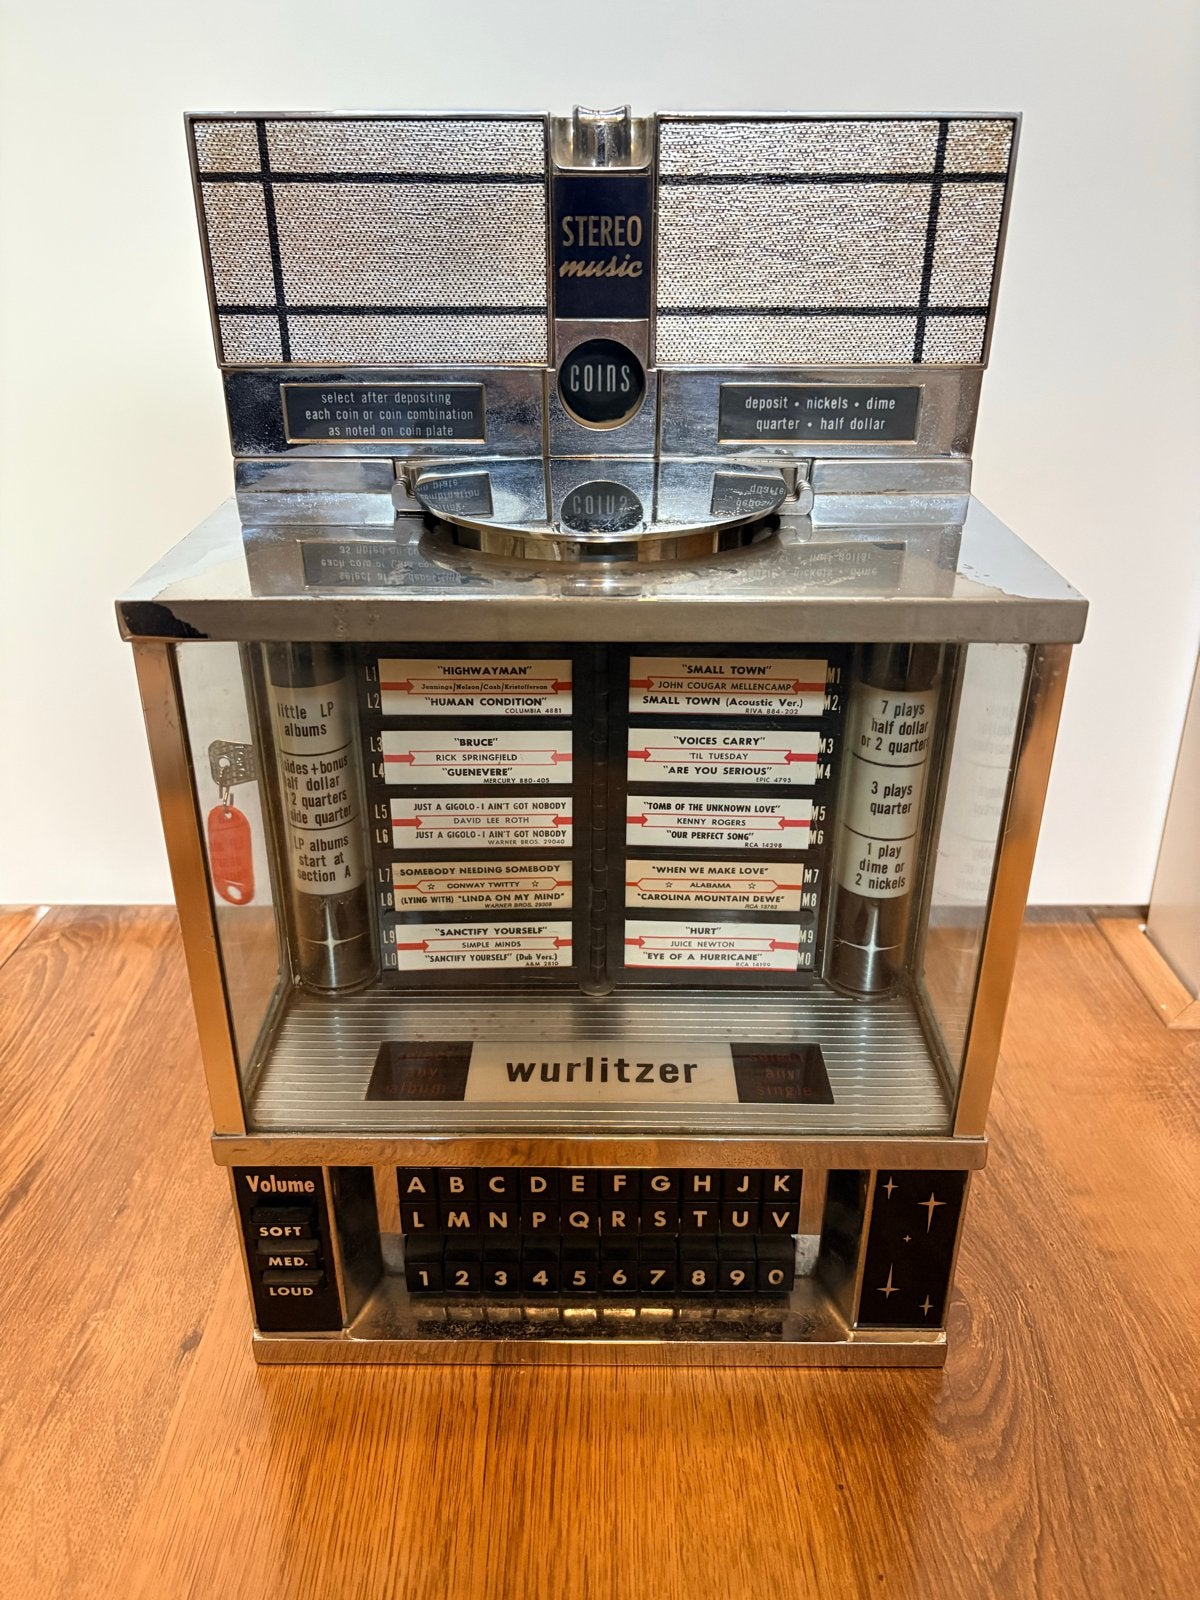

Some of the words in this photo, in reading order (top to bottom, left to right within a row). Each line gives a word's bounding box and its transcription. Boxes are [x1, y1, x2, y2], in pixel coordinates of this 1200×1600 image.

[562, 216, 642, 246] STEREO
[560, 254, 642, 278] music
[322, 392, 354, 404] select
[362, 392, 388, 403] after
[395, 392, 451, 405] depositing
[745, 397, 788, 411] deposit
[807, 397, 848, 409] nickels
[867, 398, 895, 409] dime
[306, 409, 330, 420] each
[336, 409, 358, 420] coin
[364, 411, 373, 420] or
[380, 409, 401, 420] coin
[407, 409, 473, 420] combination
[757, 419, 800, 431] quarter
[821, 418, 844, 429] half
[850, 418, 885, 429] dollar
[329, 427, 340, 435] as
[346, 425, 375, 436] noted
[381, 427, 393, 436] on
[400, 425, 421, 435] coin
[427, 425, 453, 438] plate
[438, 666, 531, 675] "HIGHWAYMAN"
[682, 664, 724, 674] "SMALL
[731, 666, 771, 675] TOWN"
[658, 681, 683, 689] JOHN
[688, 682, 727, 690] COUGAR
[731, 683, 792, 691] MELLENCAMP
[425, 697, 474, 706] "HUMAN
[480, 697, 547, 706] CONDITION"
[643, 696, 679, 705] SMALL
[686, 697, 720, 706] TOWN
[726, 697, 773, 707] (Acoustic
[780, 698, 803, 708] Ver.)
[277, 703, 306, 720] little
[321, 702, 334, 718] LP
[882, 700, 888, 714] 7
[894, 703, 925, 719] plays
[285, 723, 327, 737] albums
[872, 718, 894, 735] half
[899, 721, 928, 735] dollar
[454, 738, 498, 747] "BRUCE"
[674, 736, 717, 745] "VOICES
[723, 737, 765, 745] CARRY"
[443, 768, 512, 777] "GUENEVERE"
[663, 766, 688, 774] "ARE
[694, 767, 717, 775] YOU
[723, 767, 772, 775] SERIOUS"
[306, 776, 340, 791] dollar
[871, 781, 878, 794] 3
[884, 783, 912, 799] plays
[302, 790, 347, 809] quarters
[414, 803, 432, 811] JUST
[436, 803, 441, 811] A
[446, 803, 474, 811] GIGOLO
[514, 802, 528, 810] GOT
[533, 802, 566, 810] NOBODY
[644, 802, 671, 810] "TOMB
[675, 803, 685, 811] OF
[706, 804, 750, 812] UNKNOWN
[754, 805, 780, 813] LOVE"
[870, 802, 912, 817] quarter
[667, 830, 687, 839] "OUR
[691, 831, 723, 840] PERFECT
[727, 832, 754, 840] SONG"
[879, 844, 901, 859] play
[400, 868, 455, 876] SOMEBODY
[506, 865, 560, 873] SOMEBODY
[860, 858, 888, 874] dime
[895, 861, 904, 872] or
[856, 873, 862, 886] 2
[868, 876, 906, 890] nickels
[401, 896, 429, 905] (LYING
[433, 896, 454, 904] WITH)
[458, 894, 491, 903] "LINDA
[534, 893, 564, 901] MIND"
[637, 893, 691, 901] "CAROLINA
[435, 928, 488, 936] "SANCTIFY
[494, 927, 547, 935] YOURSELF"
[643, 952, 666, 960] "EYE
[506, 1057, 698, 1084] wurlitzer
[246, 1174, 315, 1193] Volume
[406, 1176, 426, 1193] A
[449, 1176, 465, 1193] B
[488, 1176, 505, 1193] C
[530, 1176, 547, 1193] D
[571, 1175, 585, 1192] E
[613, 1174, 627, 1192] F
[650, 1175, 671, 1192] G
[693, 1174, 711, 1192] H
[736, 1175, 749, 1193] J
[773, 1174, 790, 1192] K
[412, 1211, 425, 1228] L
[447, 1211, 471, 1228] M
[489, 1211, 508, 1228] N
[532, 1211, 547, 1228] P
[569, 1210, 590, 1229] Q
[611, 1210, 626, 1228] R
[654, 1210, 667, 1227] S
[692, 1210, 708, 1228] T
[732, 1210, 749, 1228] U
[772, 1211, 790, 1228] V
[260, 1226, 302, 1237] SOFT
[269, 1257, 308, 1267] MED.
[418, 1270, 429, 1286] 1
[455, 1270, 470, 1286] 2
[494, 1270, 507, 1286] 3
[532, 1270, 549, 1286] 4
[572, 1270, 586, 1286] 5
[612, 1269, 627, 1285] 6
[650, 1269, 666, 1285] 7
[691, 1269, 706, 1286] 8
[729, 1269, 745, 1286] 9
[768, 1269, 784, 1285] 0
[269, 1287, 313, 1296] LOUD
